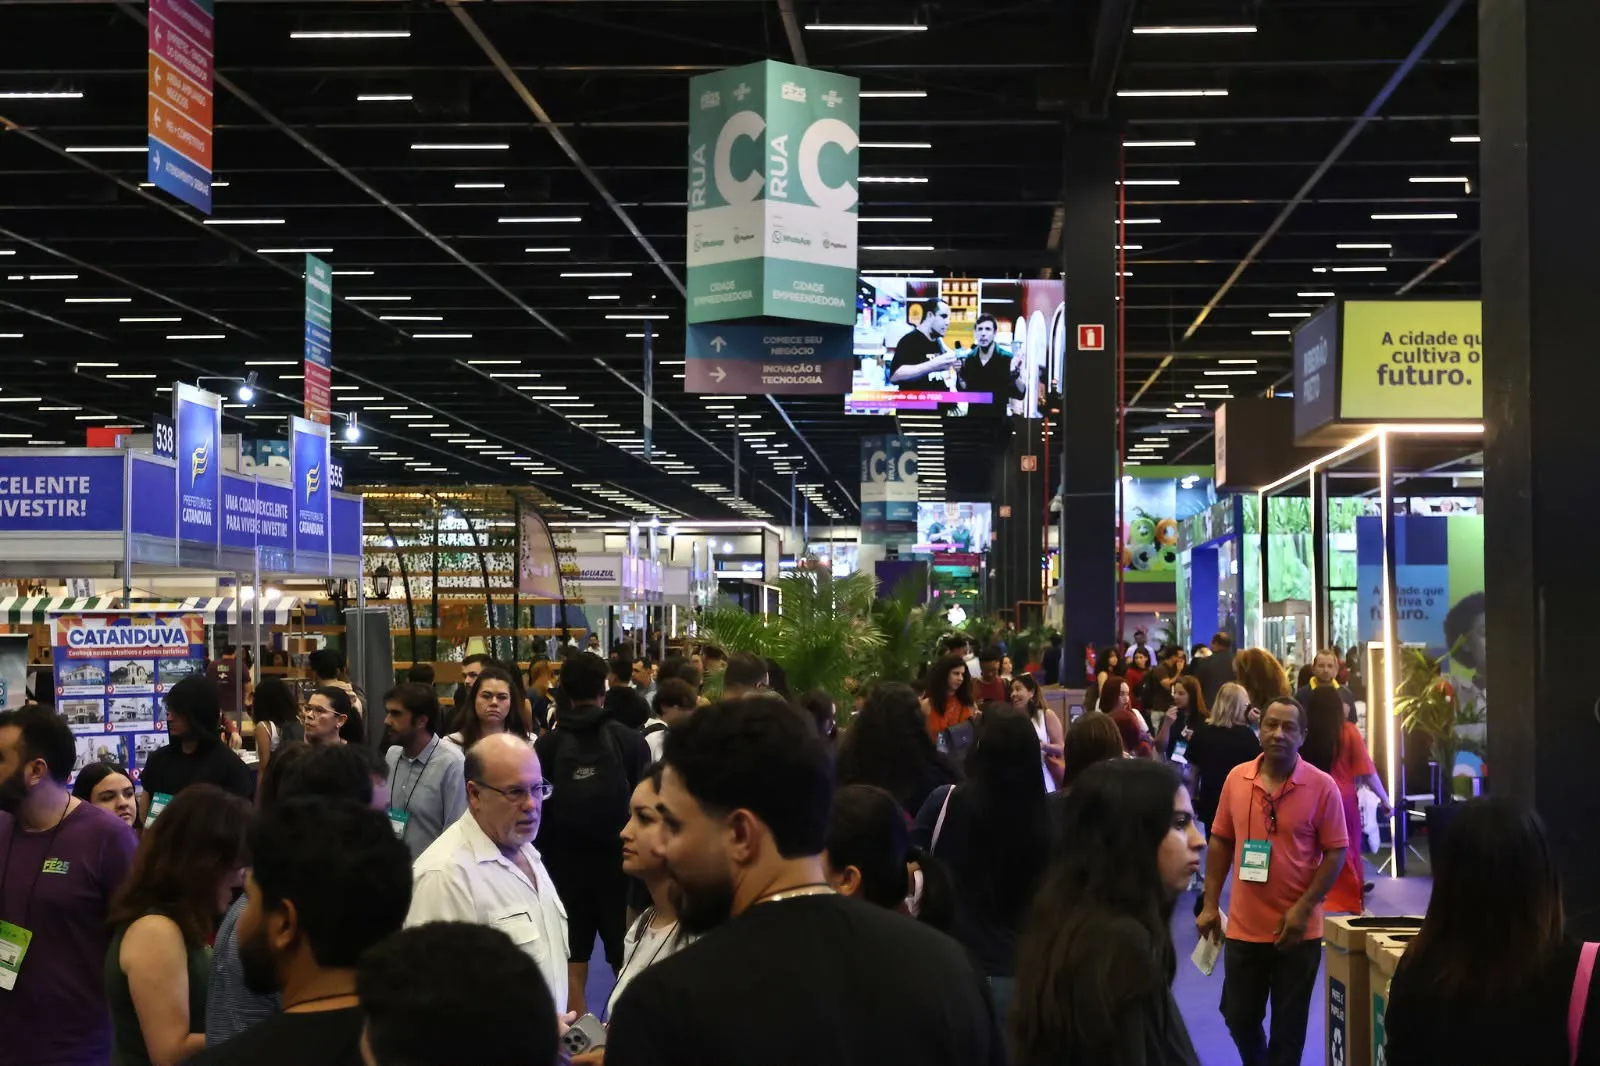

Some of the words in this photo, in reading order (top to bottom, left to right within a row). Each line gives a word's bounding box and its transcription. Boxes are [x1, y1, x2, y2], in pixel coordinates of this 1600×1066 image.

[713, 110, 767, 206] C
[770, 134, 788, 198] RUA
[798, 118, 860, 213] C
[692, 144, 706, 206] RUA
[793, 280, 824, 293] CIDADE
[772, 289, 845, 308] EMPREENDEDORA
[763, 336, 802, 344] COMECE
[804, 336, 823, 344] SEU
[1381, 332, 1393, 345] A
[1399, 331, 1458, 345] cidade
[771, 346, 814, 355] NEGÓCIO
[1392, 347, 1460, 364] cultiva
[1468, 351, 1480, 363] o
[763, 363, 814, 373] INOVAÇÃO
[815, 364, 821, 373] E
[1377, 363, 1472, 386] futuro.
[761, 376, 823, 384] TECNOLOGIA
[156, 423, 173, 453] 538
[870, 450, 887, 482] C
[898, 451, 919, 482] C
[0, 476, 90, 494] CELENTE
[330, 464, 343, 488] 555
[0, 499, 87, 517] VESTIR!
[225, 494, 239, 511] UMA
[182, 507, 212, 526] CATANDUVA
[226, 513, 241, 532] PARA
[299, 521, 324, 536] CATANDUVA
[1426, 599, 1434, 607] o
[69, 628, 186, 645] CATANDUVA
[142, 649, 161, 657] pontos
[43, 860, 70, 871] FE25
